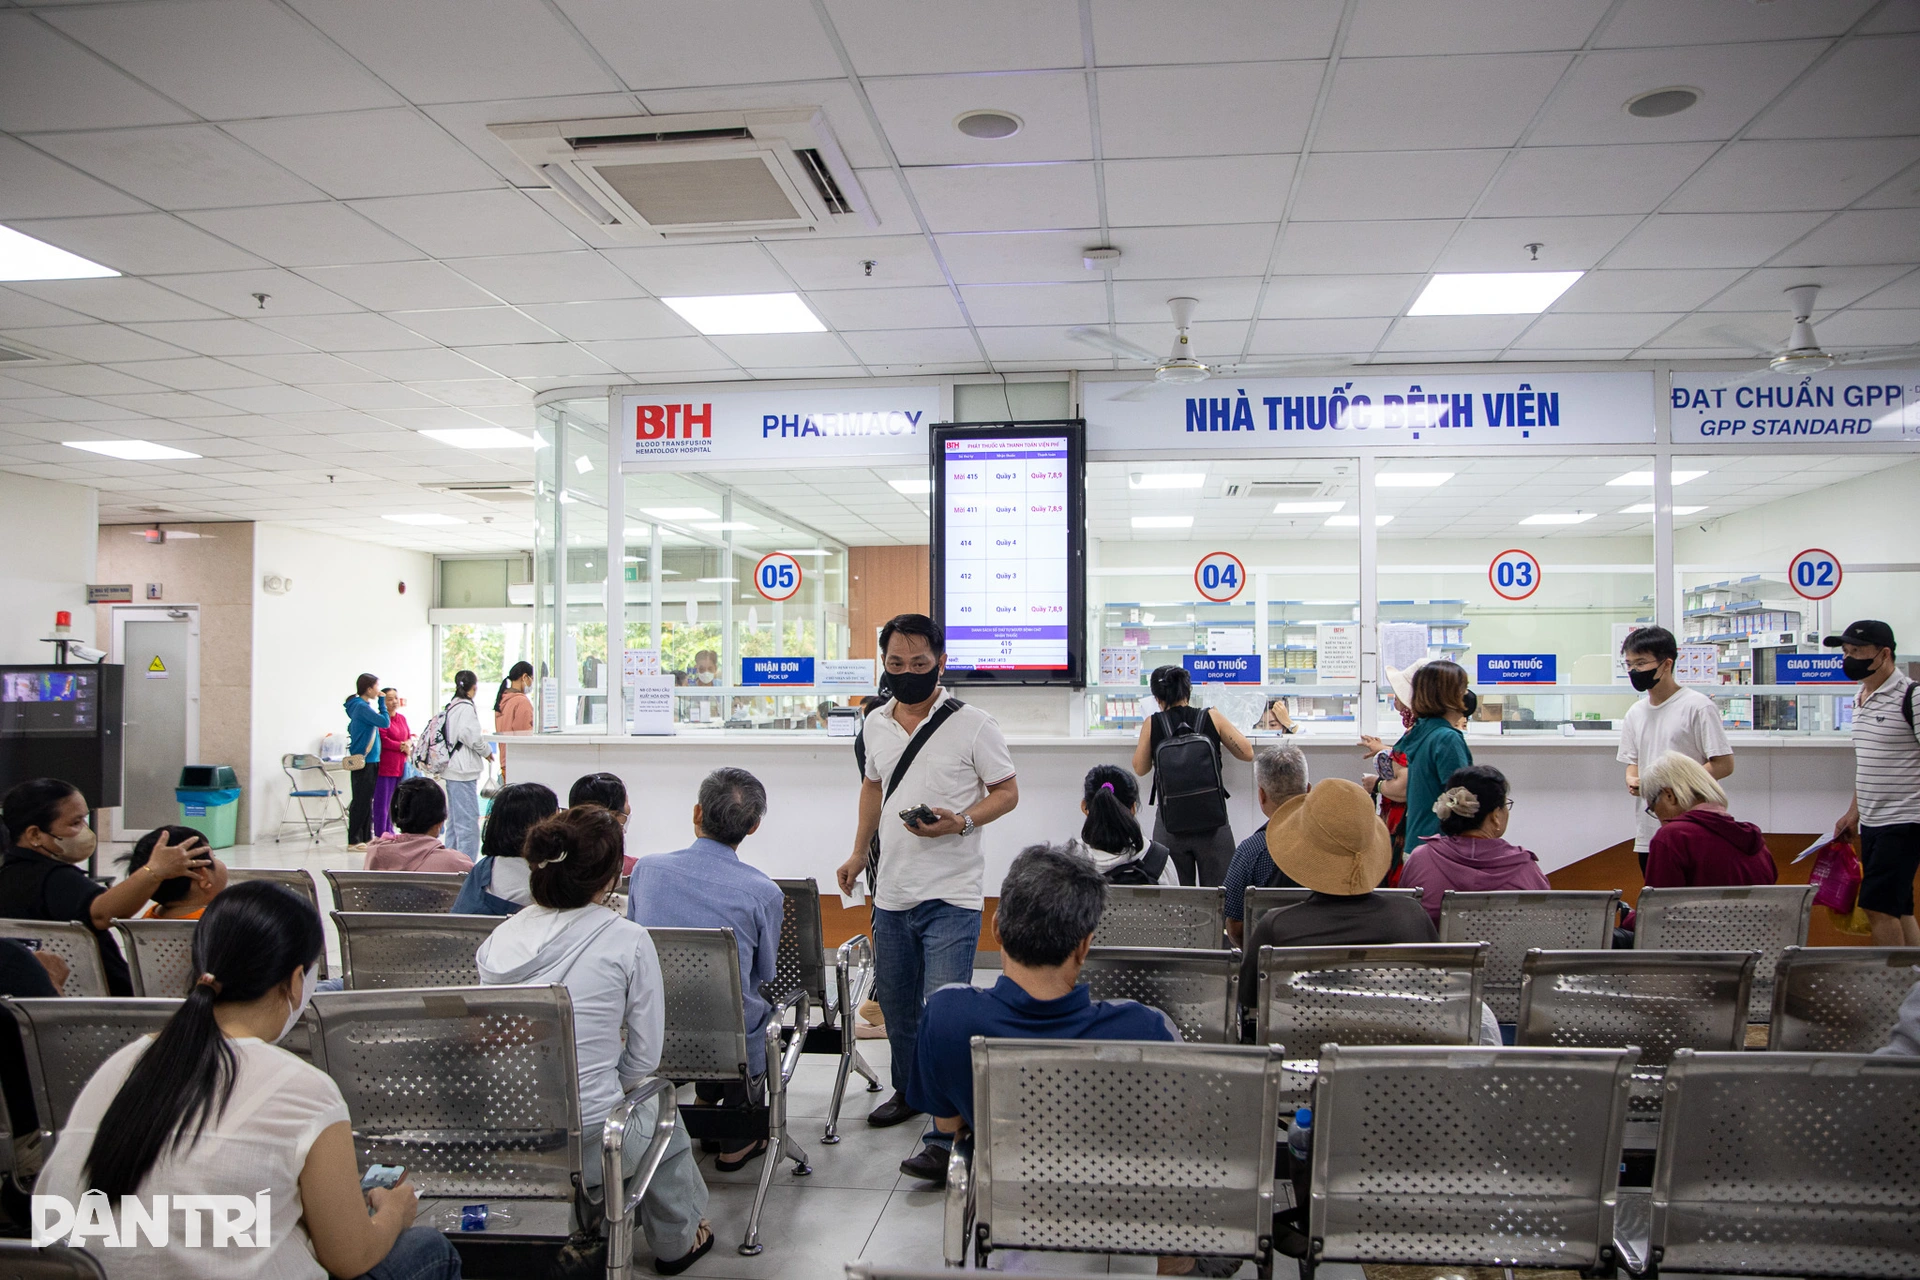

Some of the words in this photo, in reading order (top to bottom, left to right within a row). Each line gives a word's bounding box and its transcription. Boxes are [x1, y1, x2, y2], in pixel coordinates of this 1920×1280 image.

[1671, 387, 1727, 414] ĐẠT
[1735, 376, 1834, 408] CHUẨN
[1843, 385, 1902, 408] GPP
[1186, 389, 1255, 432] NHÀ
[1263, 383, 1372, 431] THUỐC
[1383, 385, 1474, 440] BỆNH
[1482, 384, 1559, 438] VIỆN
[636, 404, 712, 440] BTH
[763, 410, 923, 438] PHARMACY
[1700, 419, 1746, 436] GPP
[1752, 418, 1872, 436] STANDARD
[1031, 472, 1046, 480] Quầy
[996, 506, 1011, 514] Quầy
[762, 564, 794, 589] 05
[996, 572, 1011, 580] Quầy
[1203, 564, 1237, 589] 04
[1497, 562, 1532, 587] 03
[1797, 561, 1833, 587] 02
[996, 605, 1011, 613] Quầy
[755, 661, 778, 673] NHẬN
[781, 662, 799, 672] ĐƠN
[1194, 661, 1215, 670] GIAO
[1217, 657, 1247, 670] THUỐC
[1488, 660, 1510, 669] GIAO
[1512, 657, 1543, 669] THUỐC
[1787, 660, 1810, 669] GIAO
[1812, 656, 1843, 669] THUỐC
